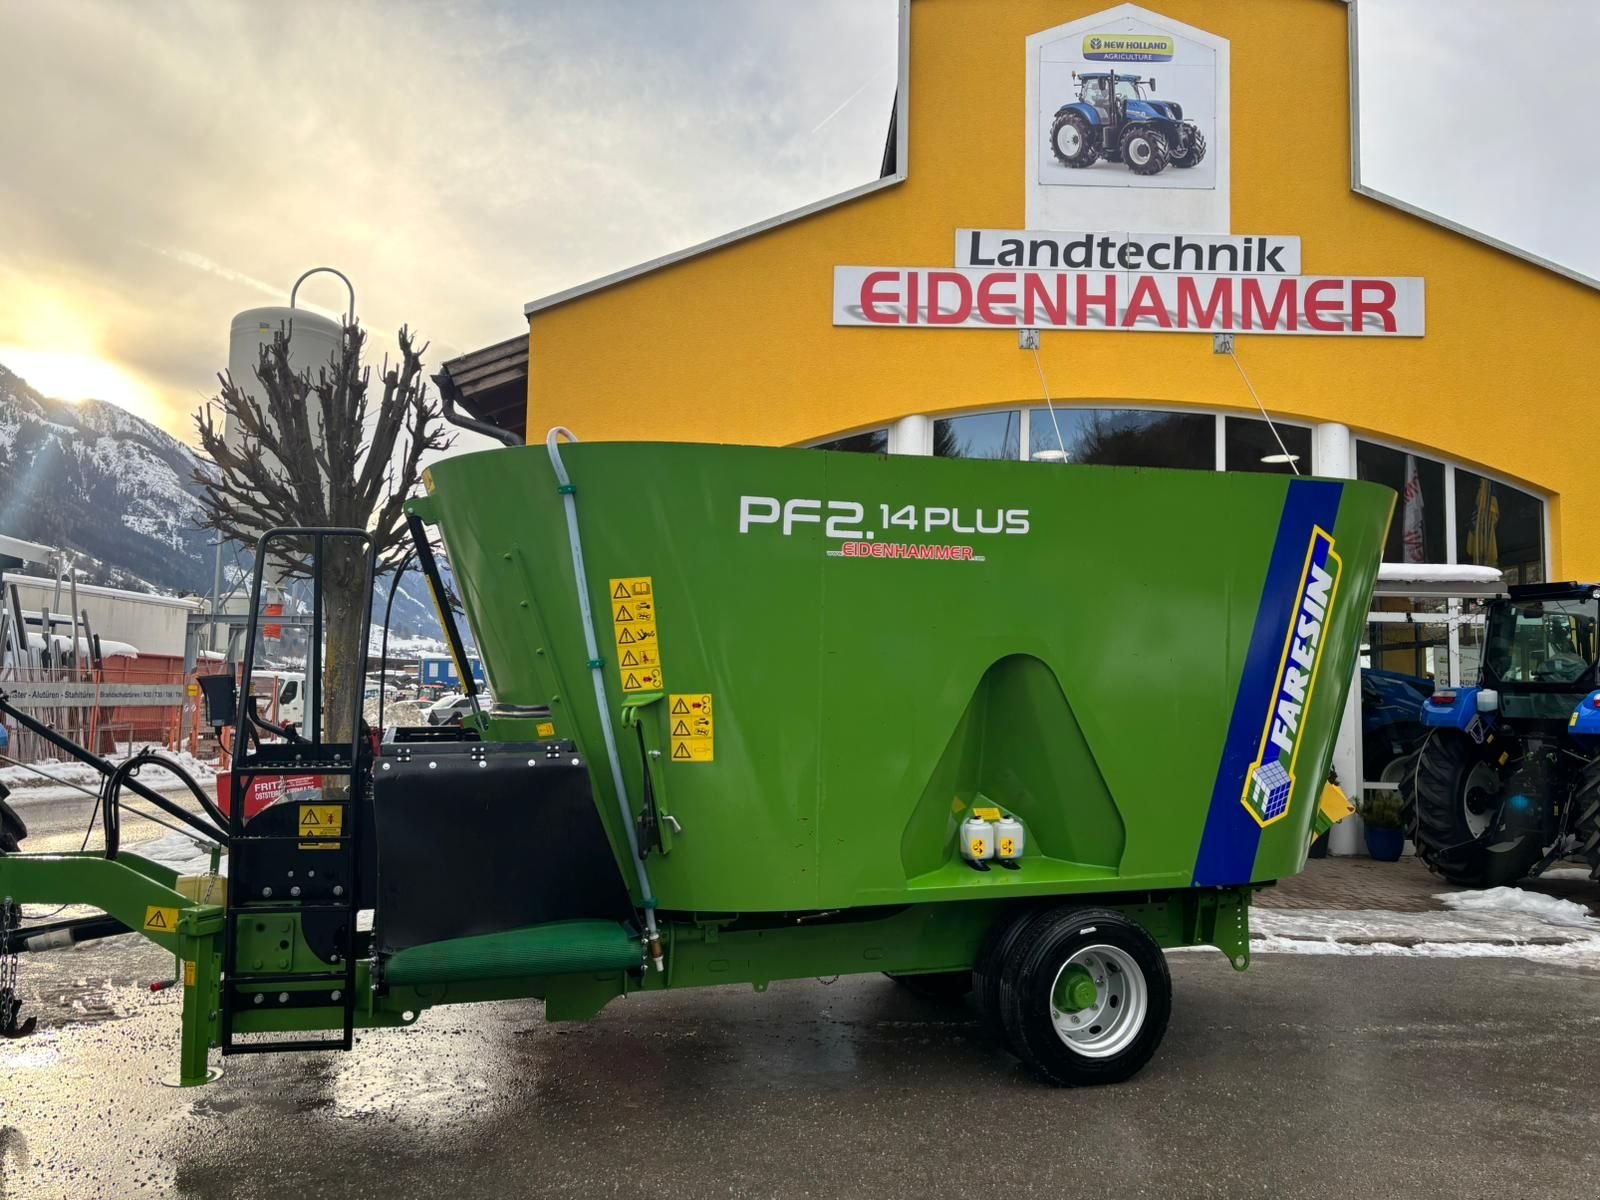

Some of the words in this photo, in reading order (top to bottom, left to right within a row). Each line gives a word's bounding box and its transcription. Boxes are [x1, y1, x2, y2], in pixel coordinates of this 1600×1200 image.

[1103, 53, 1153, 61] AGRICULTURE
[1104, 41, 1125, 49] NEW
[1126, 41, 1167, 50] HOLLAND
[969, 231, 1287, 273] Landtechnik
[859, 270, 1398, 333] EIDENHAMMER
[925, 507, 1030, 535] PLUS
[1271, 561, 1334, 755] FARESIN
